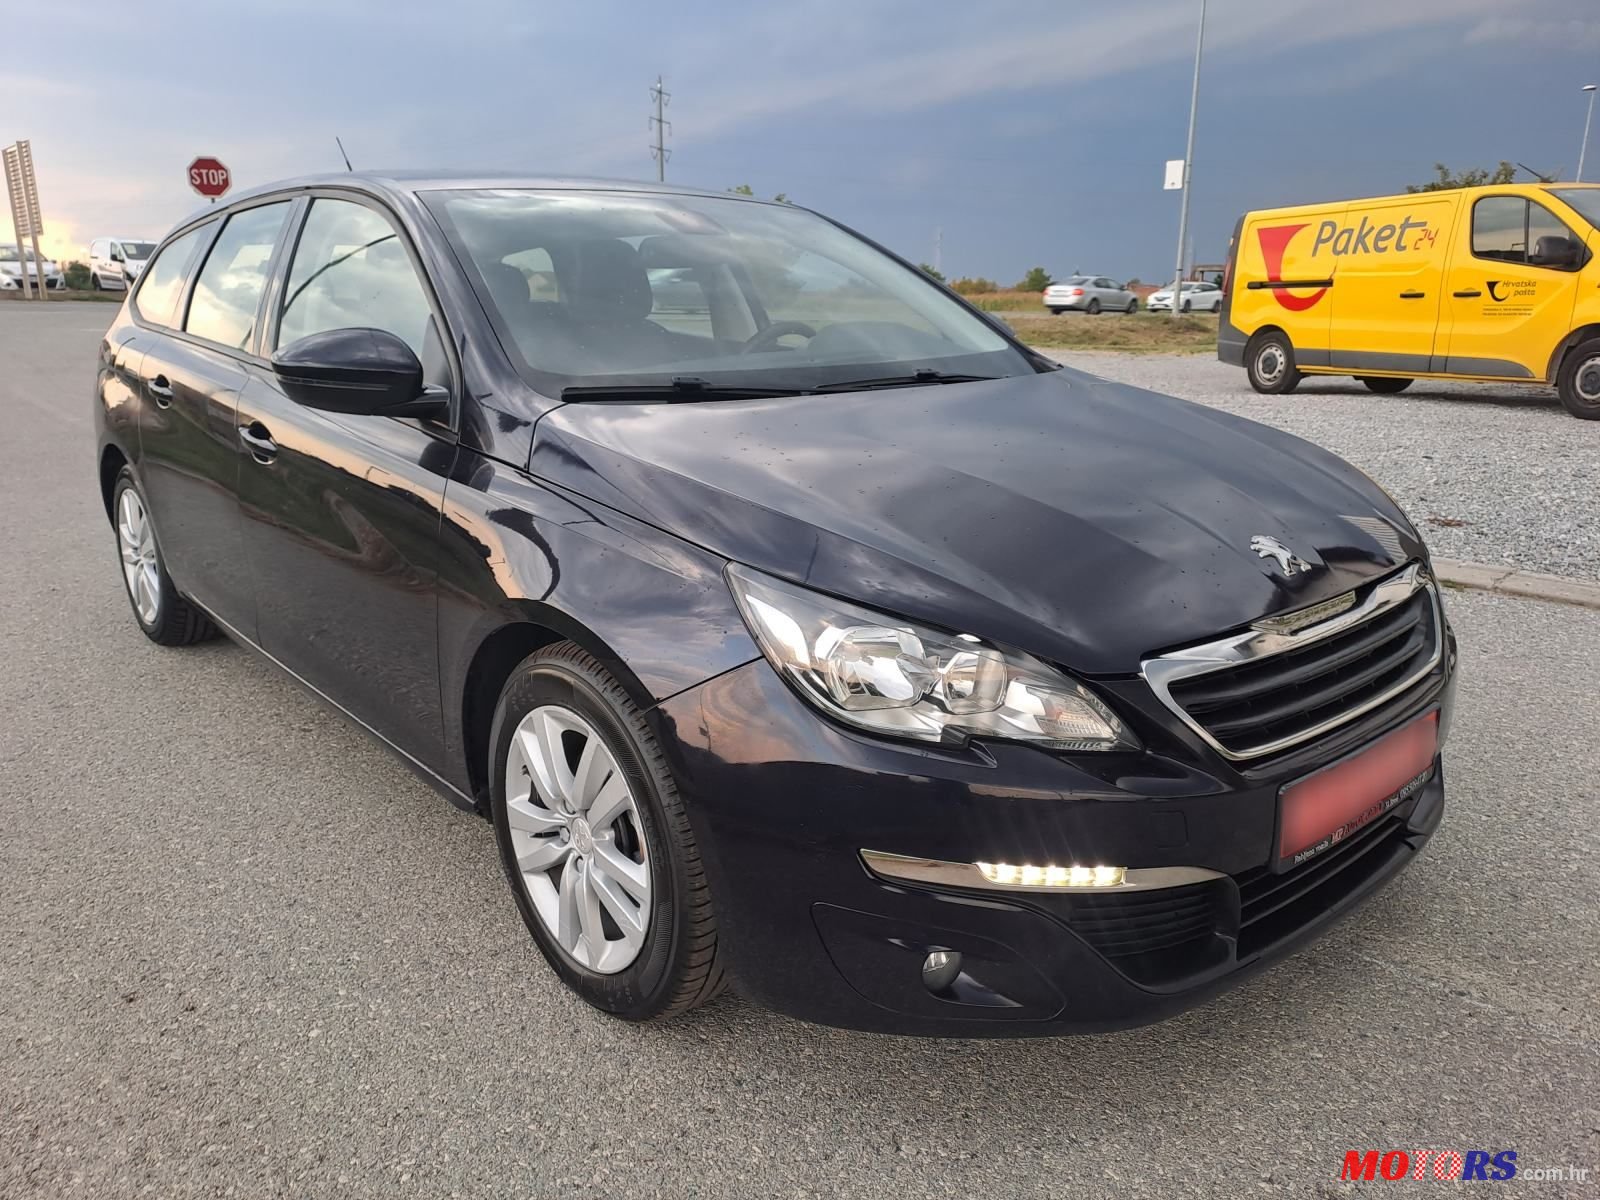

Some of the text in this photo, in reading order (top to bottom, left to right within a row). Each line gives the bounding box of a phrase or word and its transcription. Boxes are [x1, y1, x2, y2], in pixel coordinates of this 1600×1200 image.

[190, 168, 227, 185] STOP
[1312, 215, 1439, 257] Paket 24
[1502, 280, 1536, 288] Hrvatska
